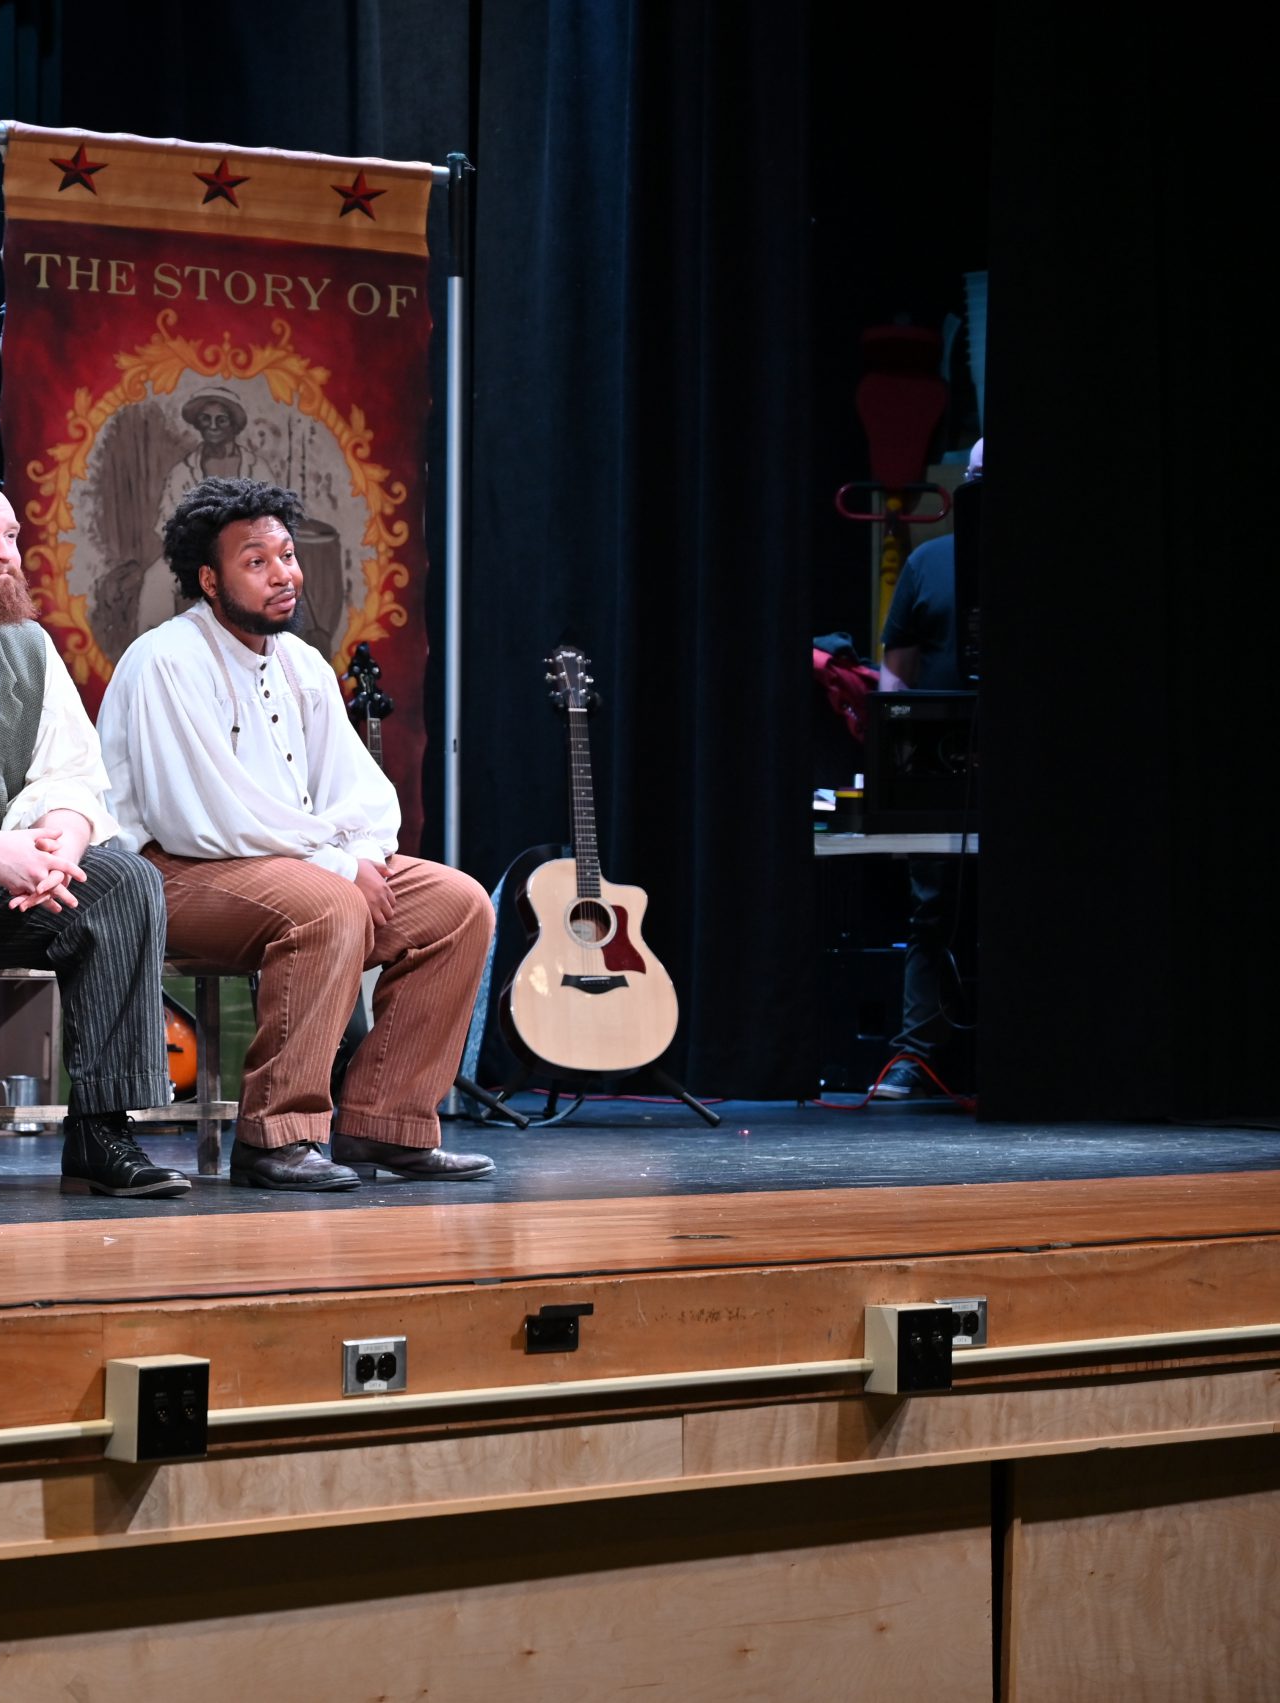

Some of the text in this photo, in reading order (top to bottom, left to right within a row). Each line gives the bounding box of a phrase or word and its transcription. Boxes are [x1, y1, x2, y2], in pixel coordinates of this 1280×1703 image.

[25, 252, 417, 318] THE STORY OF
